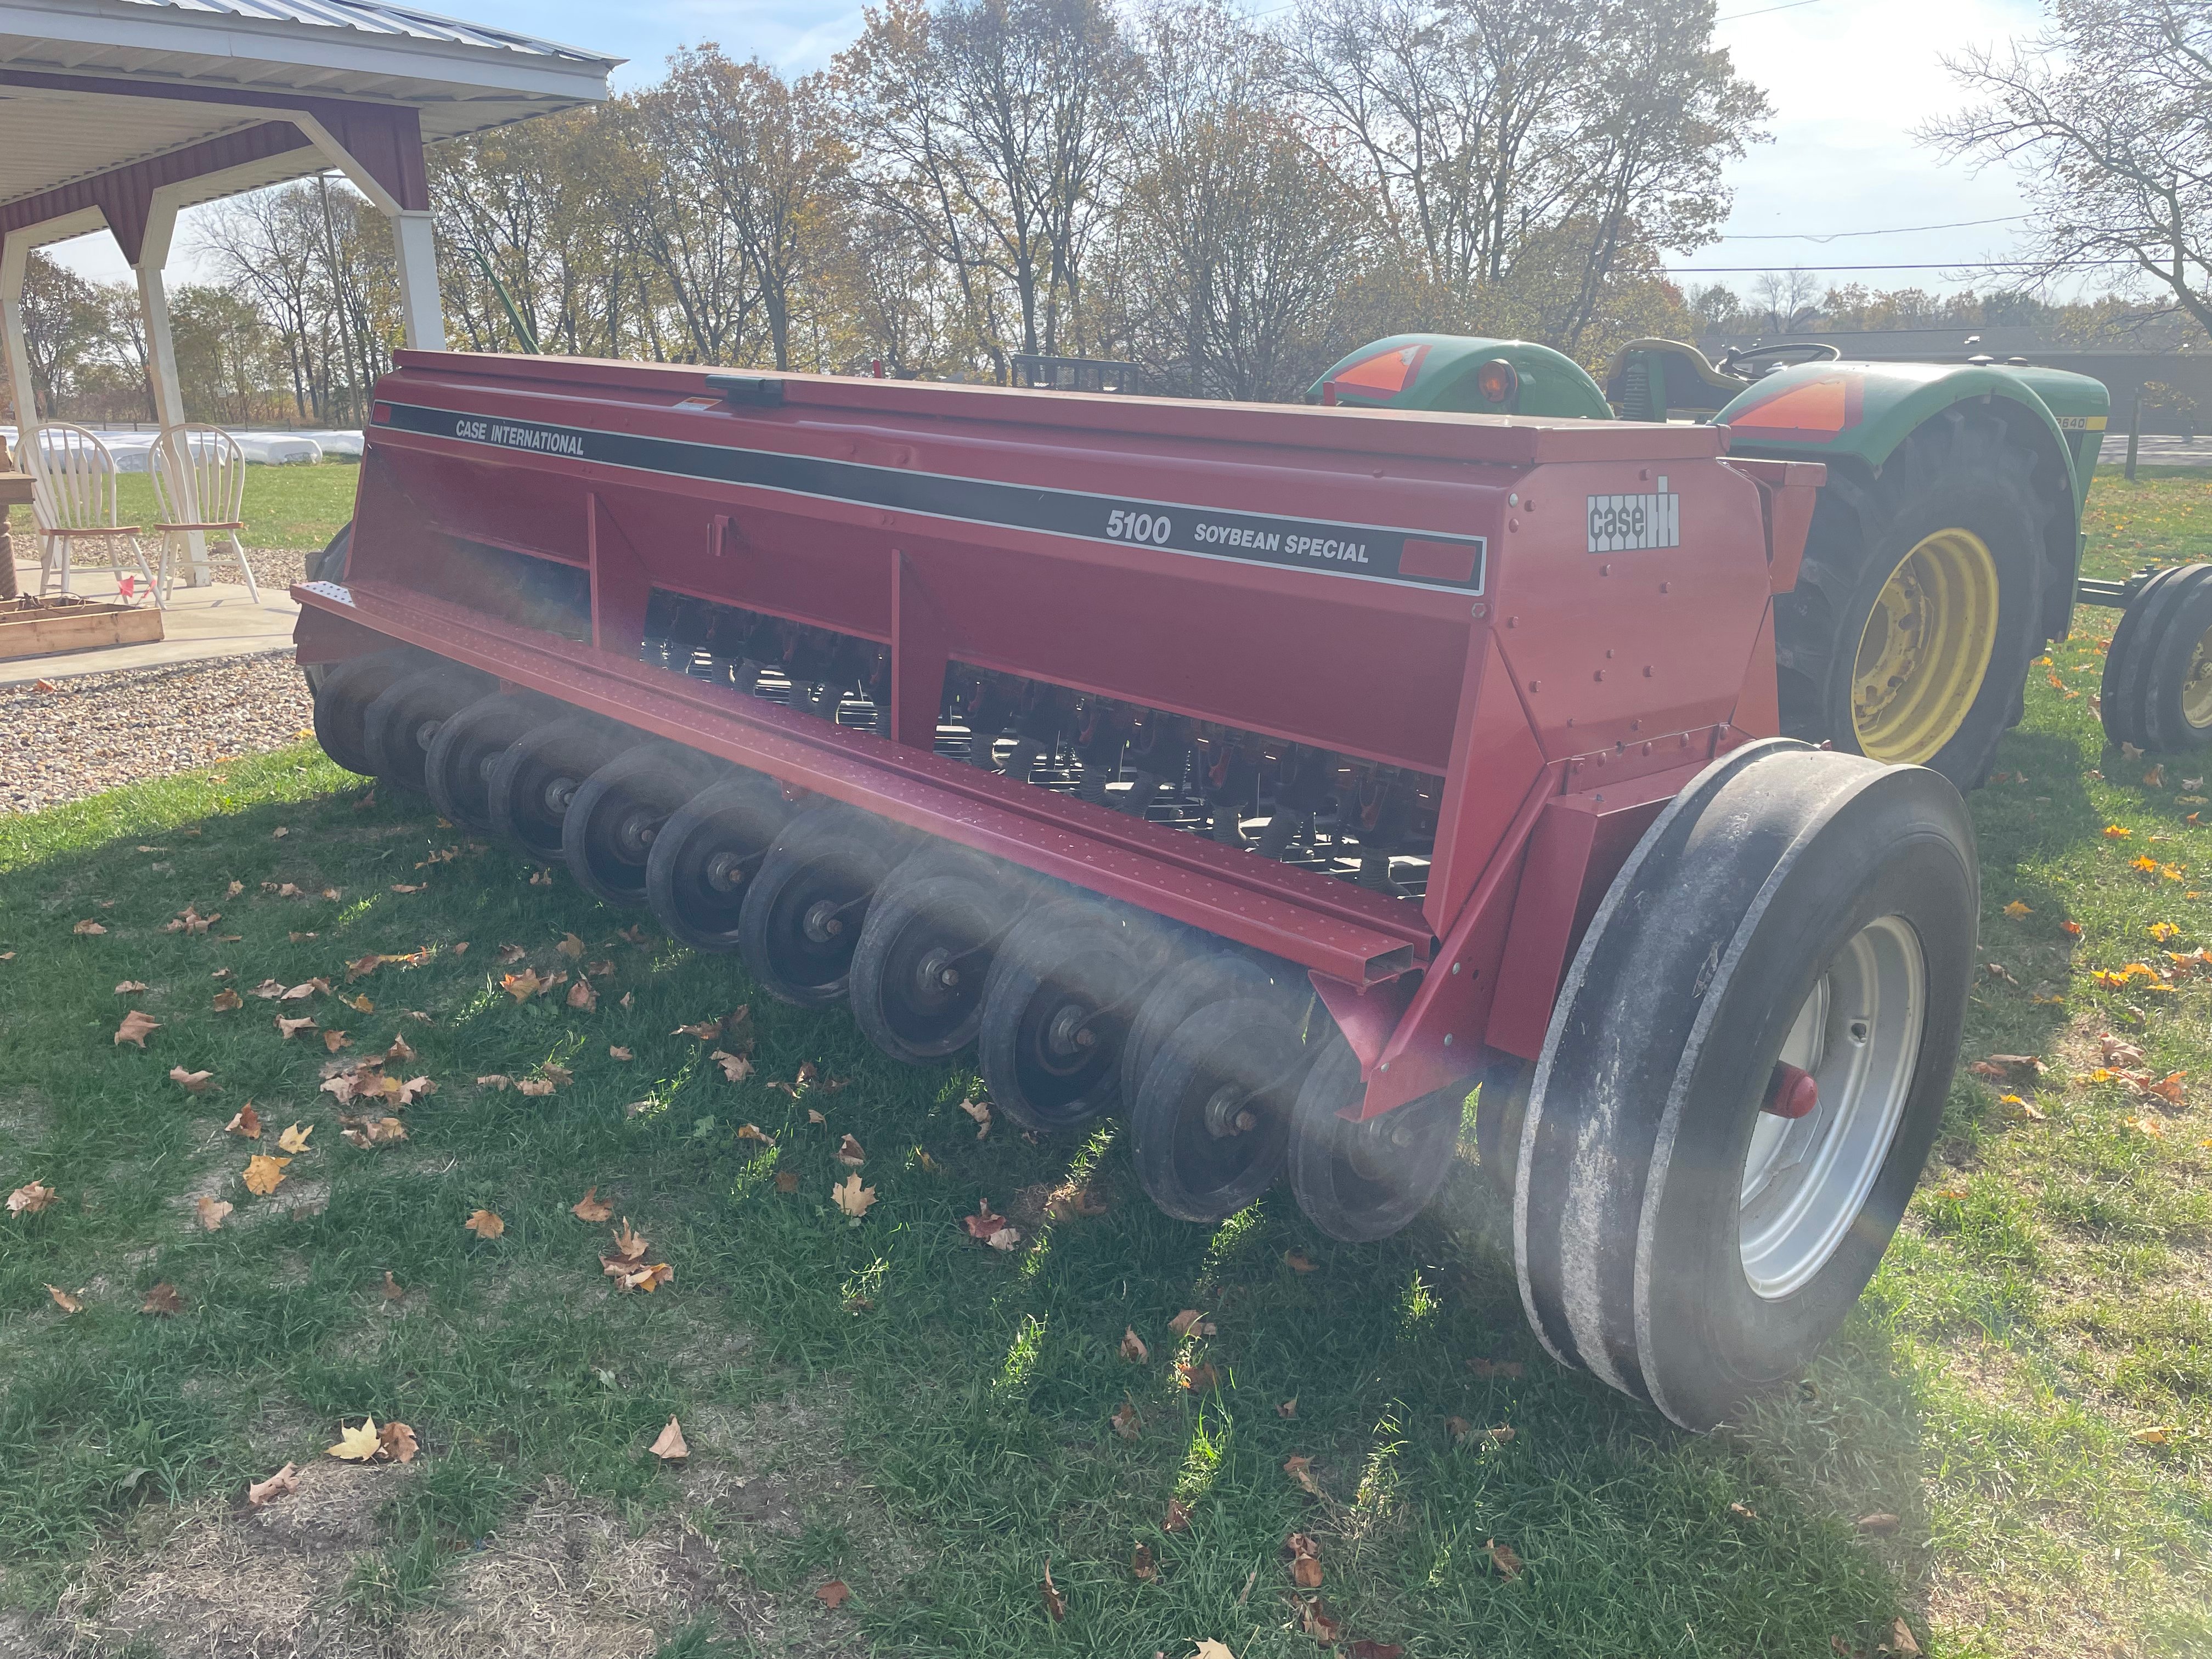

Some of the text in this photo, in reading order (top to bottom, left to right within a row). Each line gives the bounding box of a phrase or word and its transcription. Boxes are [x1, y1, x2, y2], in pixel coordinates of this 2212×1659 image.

[456, 420, 584, 456] CASE INTERNATIONAL
[1106, 510, 1369, 564] 5100 SOYBEAN SPECIAL
